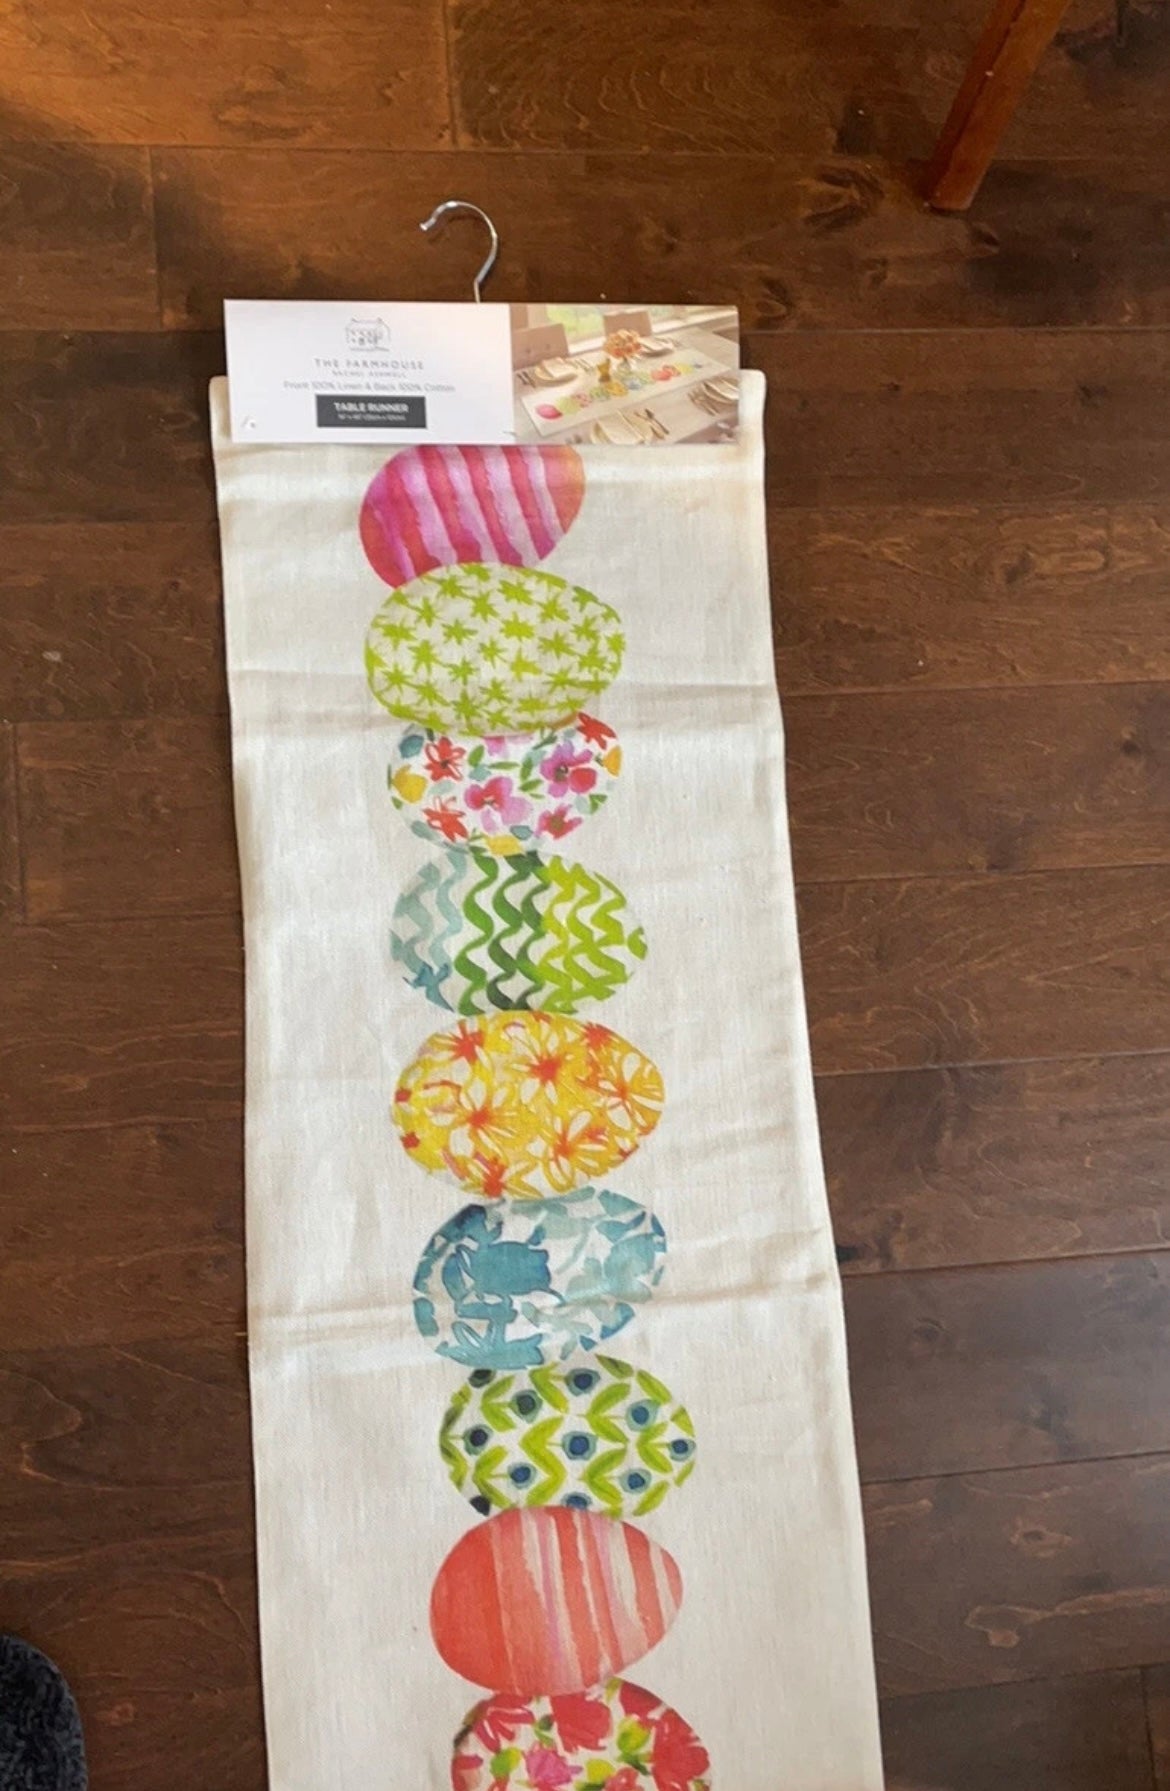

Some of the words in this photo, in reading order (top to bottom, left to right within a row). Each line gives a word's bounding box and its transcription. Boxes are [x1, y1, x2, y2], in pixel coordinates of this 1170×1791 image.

[314, 358, 339, 368] THE
[346, 359, 424, 370] FARMHOUSE
[284, 380, 309, 389] Front
[338, 382, 363, 390] Linen
[374, 382, 396, 391] Back
[425, 383, 456, 392] Cotton
[334, 402, 365, 412] TABLE
[369, 403, 409, 413] RUNNER
